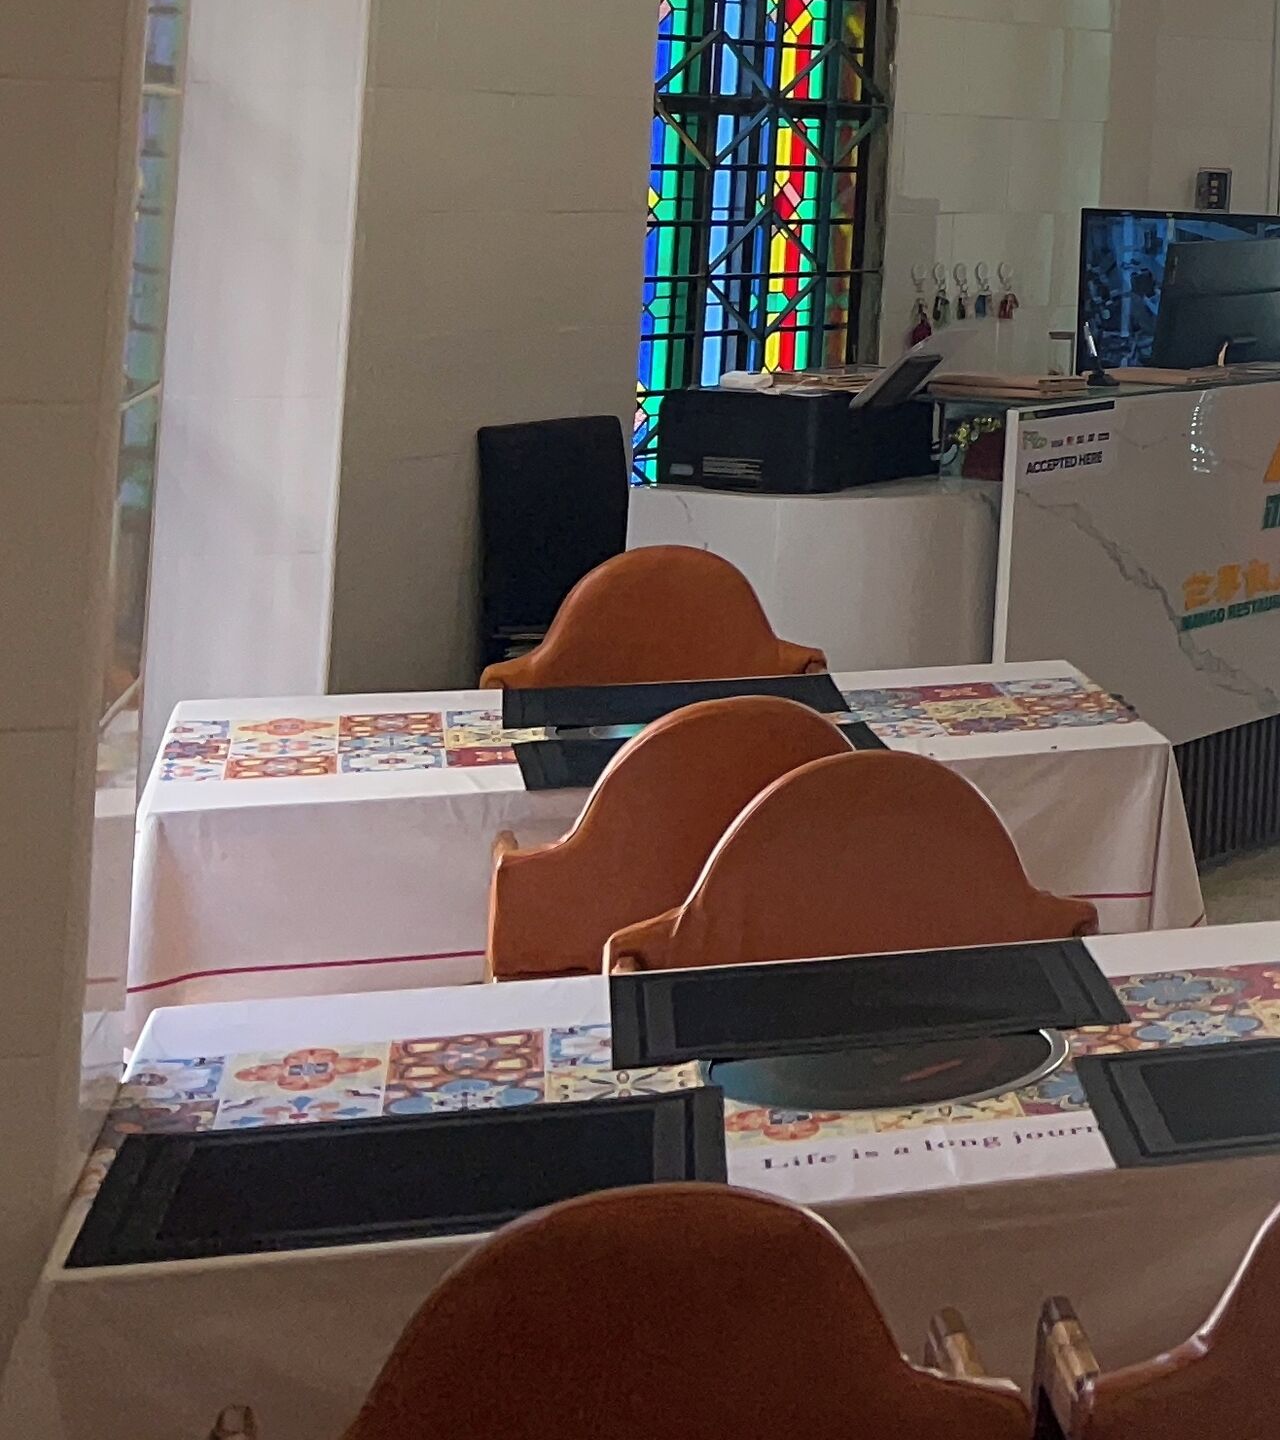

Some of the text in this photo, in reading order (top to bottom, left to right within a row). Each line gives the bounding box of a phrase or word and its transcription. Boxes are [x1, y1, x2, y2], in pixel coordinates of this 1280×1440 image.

[1026, 450, 1103, 475] ACCEPTED HERE
[763, 1151, 837, 1169] Life
[924, 1136, 1002, 1152] long
